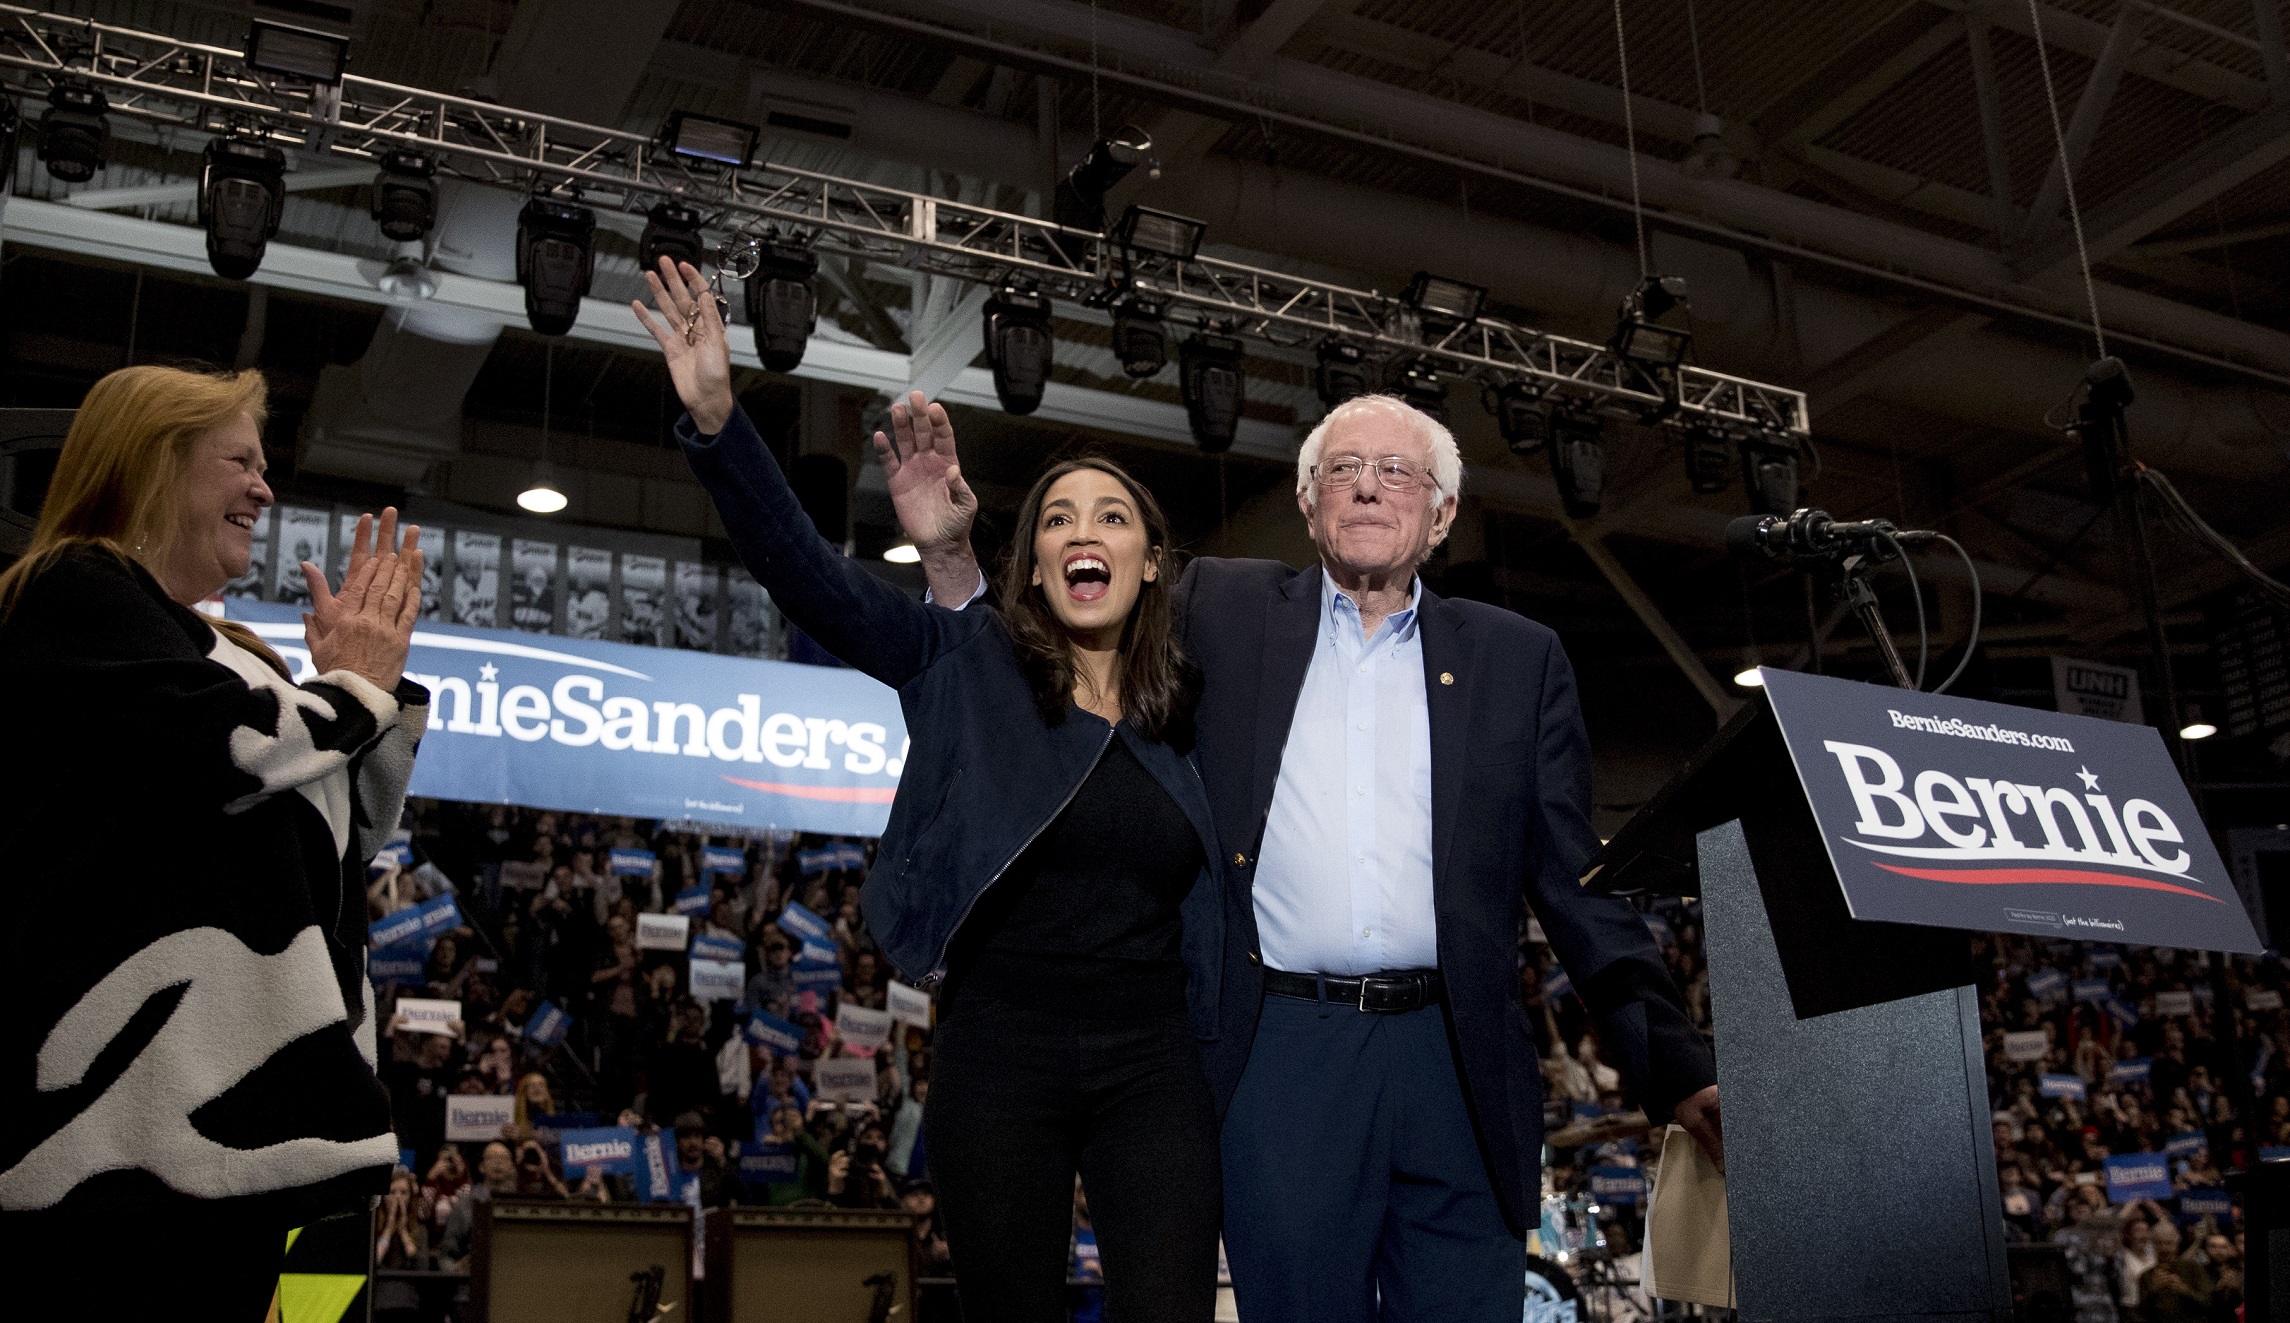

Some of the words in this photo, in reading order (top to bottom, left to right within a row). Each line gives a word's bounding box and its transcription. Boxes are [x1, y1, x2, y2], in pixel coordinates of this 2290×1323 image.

[2069, 669, 2125, 697] UNH
[1888, 708, 2075, 753] BernieSanders.com
[1823, 740, 2190, 873] Bernie
[2088, 917, 2124, 931] billionaires)
[452, 1107, 510, 1127] Bernie
[566, 1138, 632, 1162] Bernie
[644, 1135, 670, 1197] Bernie
[2110, 1165, 2167, 1186] Bernie
[1592, 1176, 1644, 1194] Bernie
[2182, 1196, 2229, 1214] Bernie
